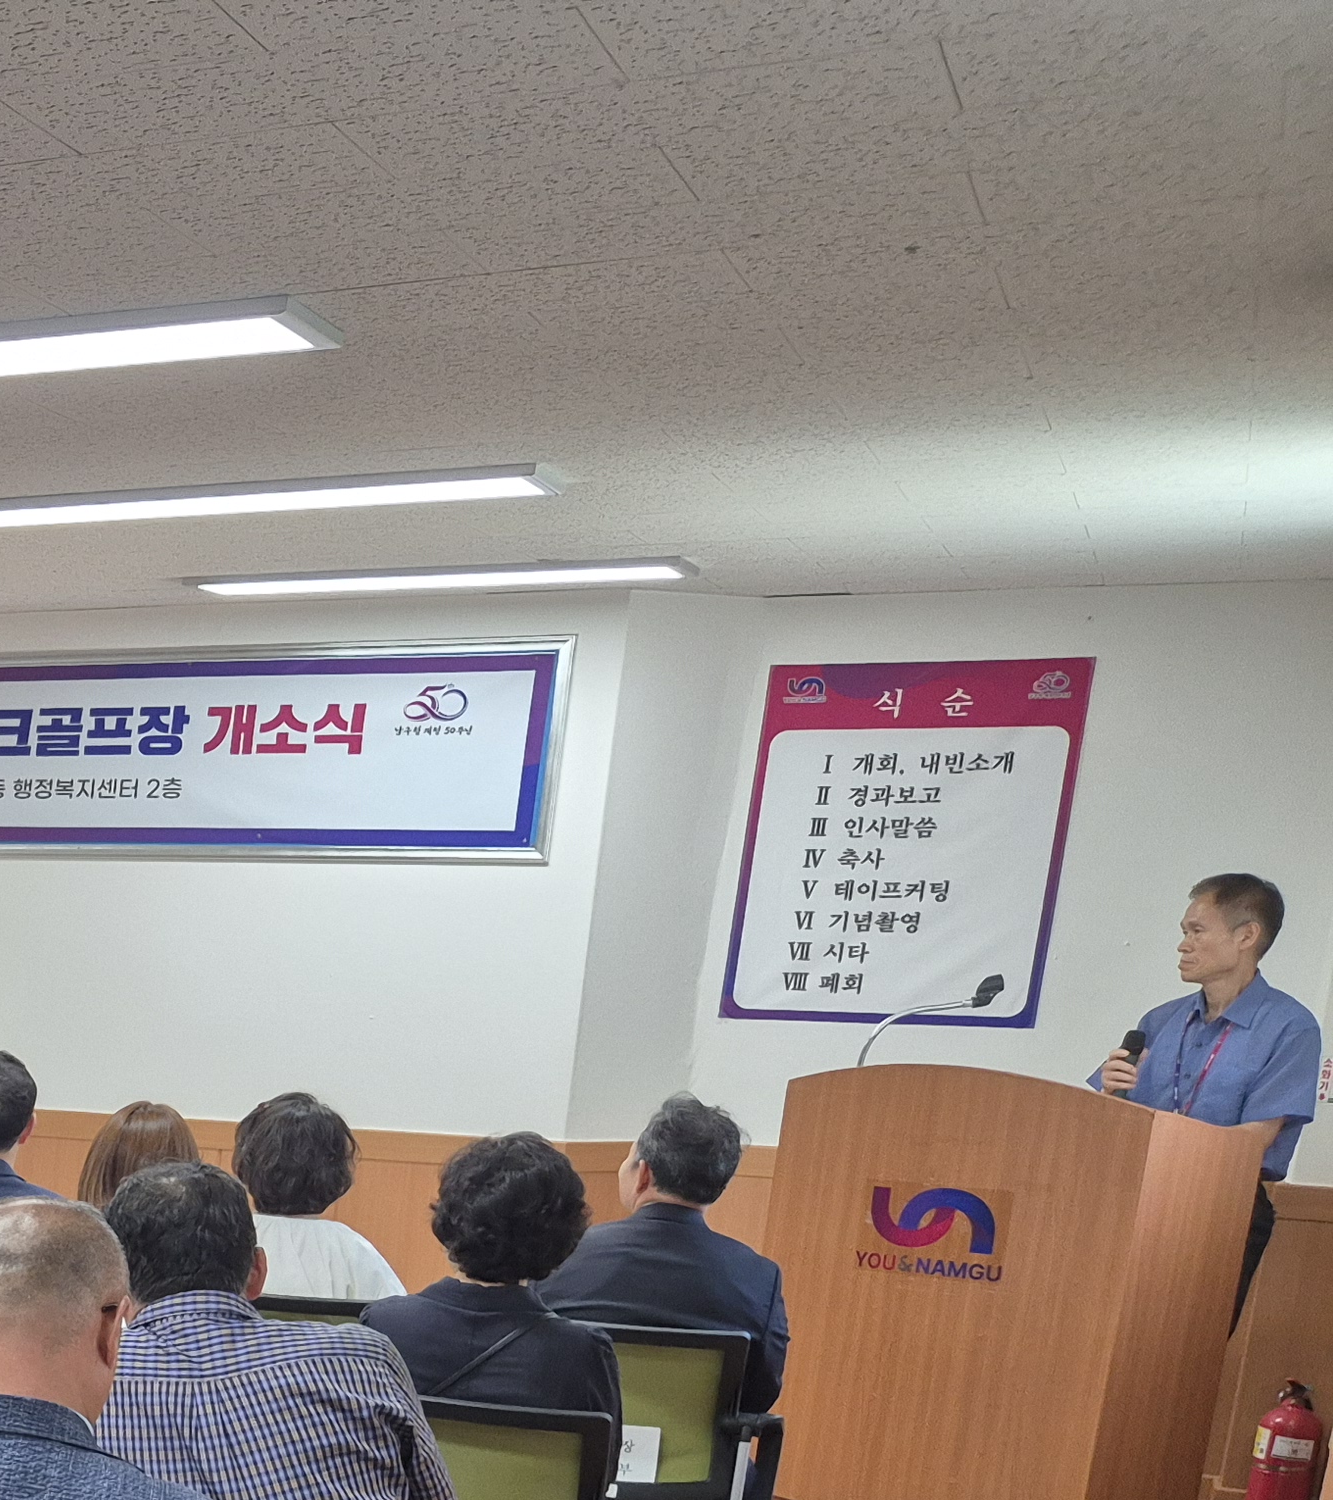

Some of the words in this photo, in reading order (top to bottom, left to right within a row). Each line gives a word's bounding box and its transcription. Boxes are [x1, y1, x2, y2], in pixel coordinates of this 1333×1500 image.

[202, 702, 367, 756] 개소식
[920, 750, 1015, 775] 내빈소개
[13, 778, 139, 800] 행정복지센터
[146, 777, 183, 800] 2층
[847, 784, 942, 808] 경과보고
[844, 816, 938, 839] 인사말씀
[837, 847, 886, 871] 축사
[834, 879, 950, 903] 테이프커팅
[828, 910, 921, 934] 기념촬영
[823, 941, 870, 965] 시타
